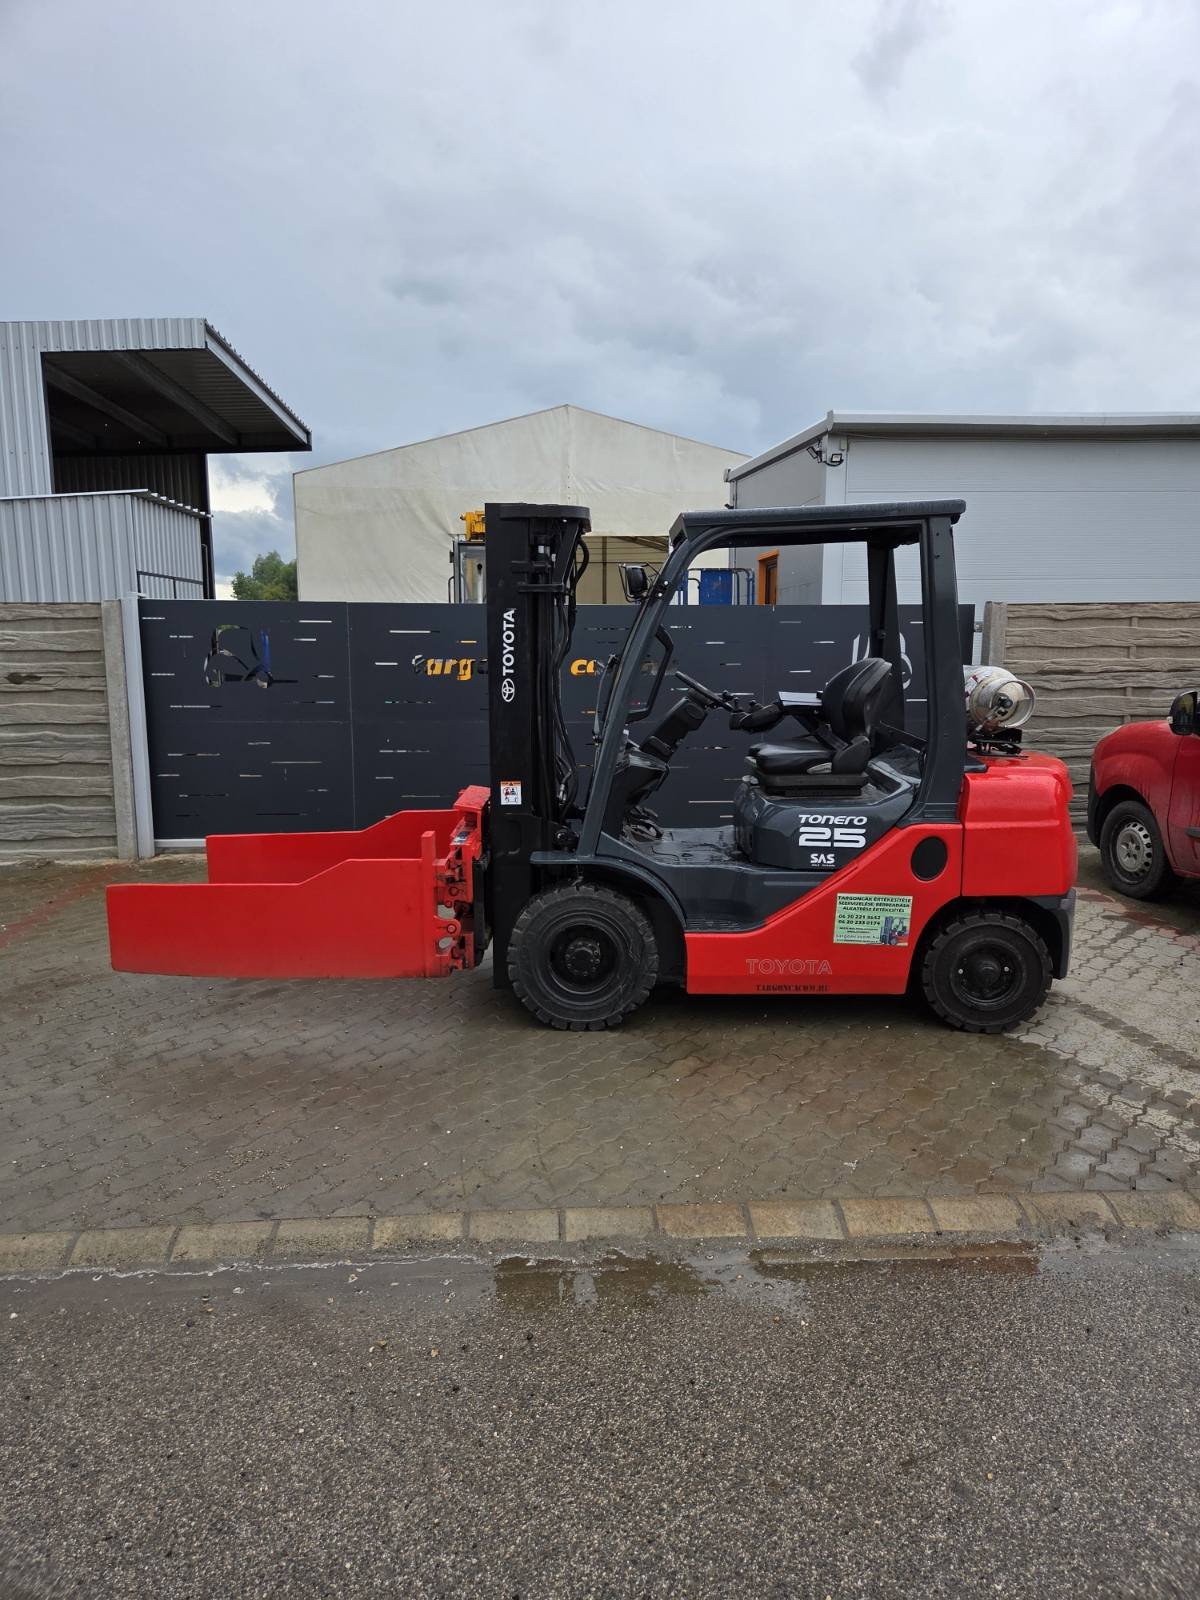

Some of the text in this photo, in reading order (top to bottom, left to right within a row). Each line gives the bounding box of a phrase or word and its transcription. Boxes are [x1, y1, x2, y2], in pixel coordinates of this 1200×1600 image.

[502, 608, 516, 677] TOYOTA
[798, 814, 868, 826] TONERO
[798, 826, 867, 849] 25
[810, 853, 835, 864] SAS
[745, 958, 833, 975] TOYOTA
